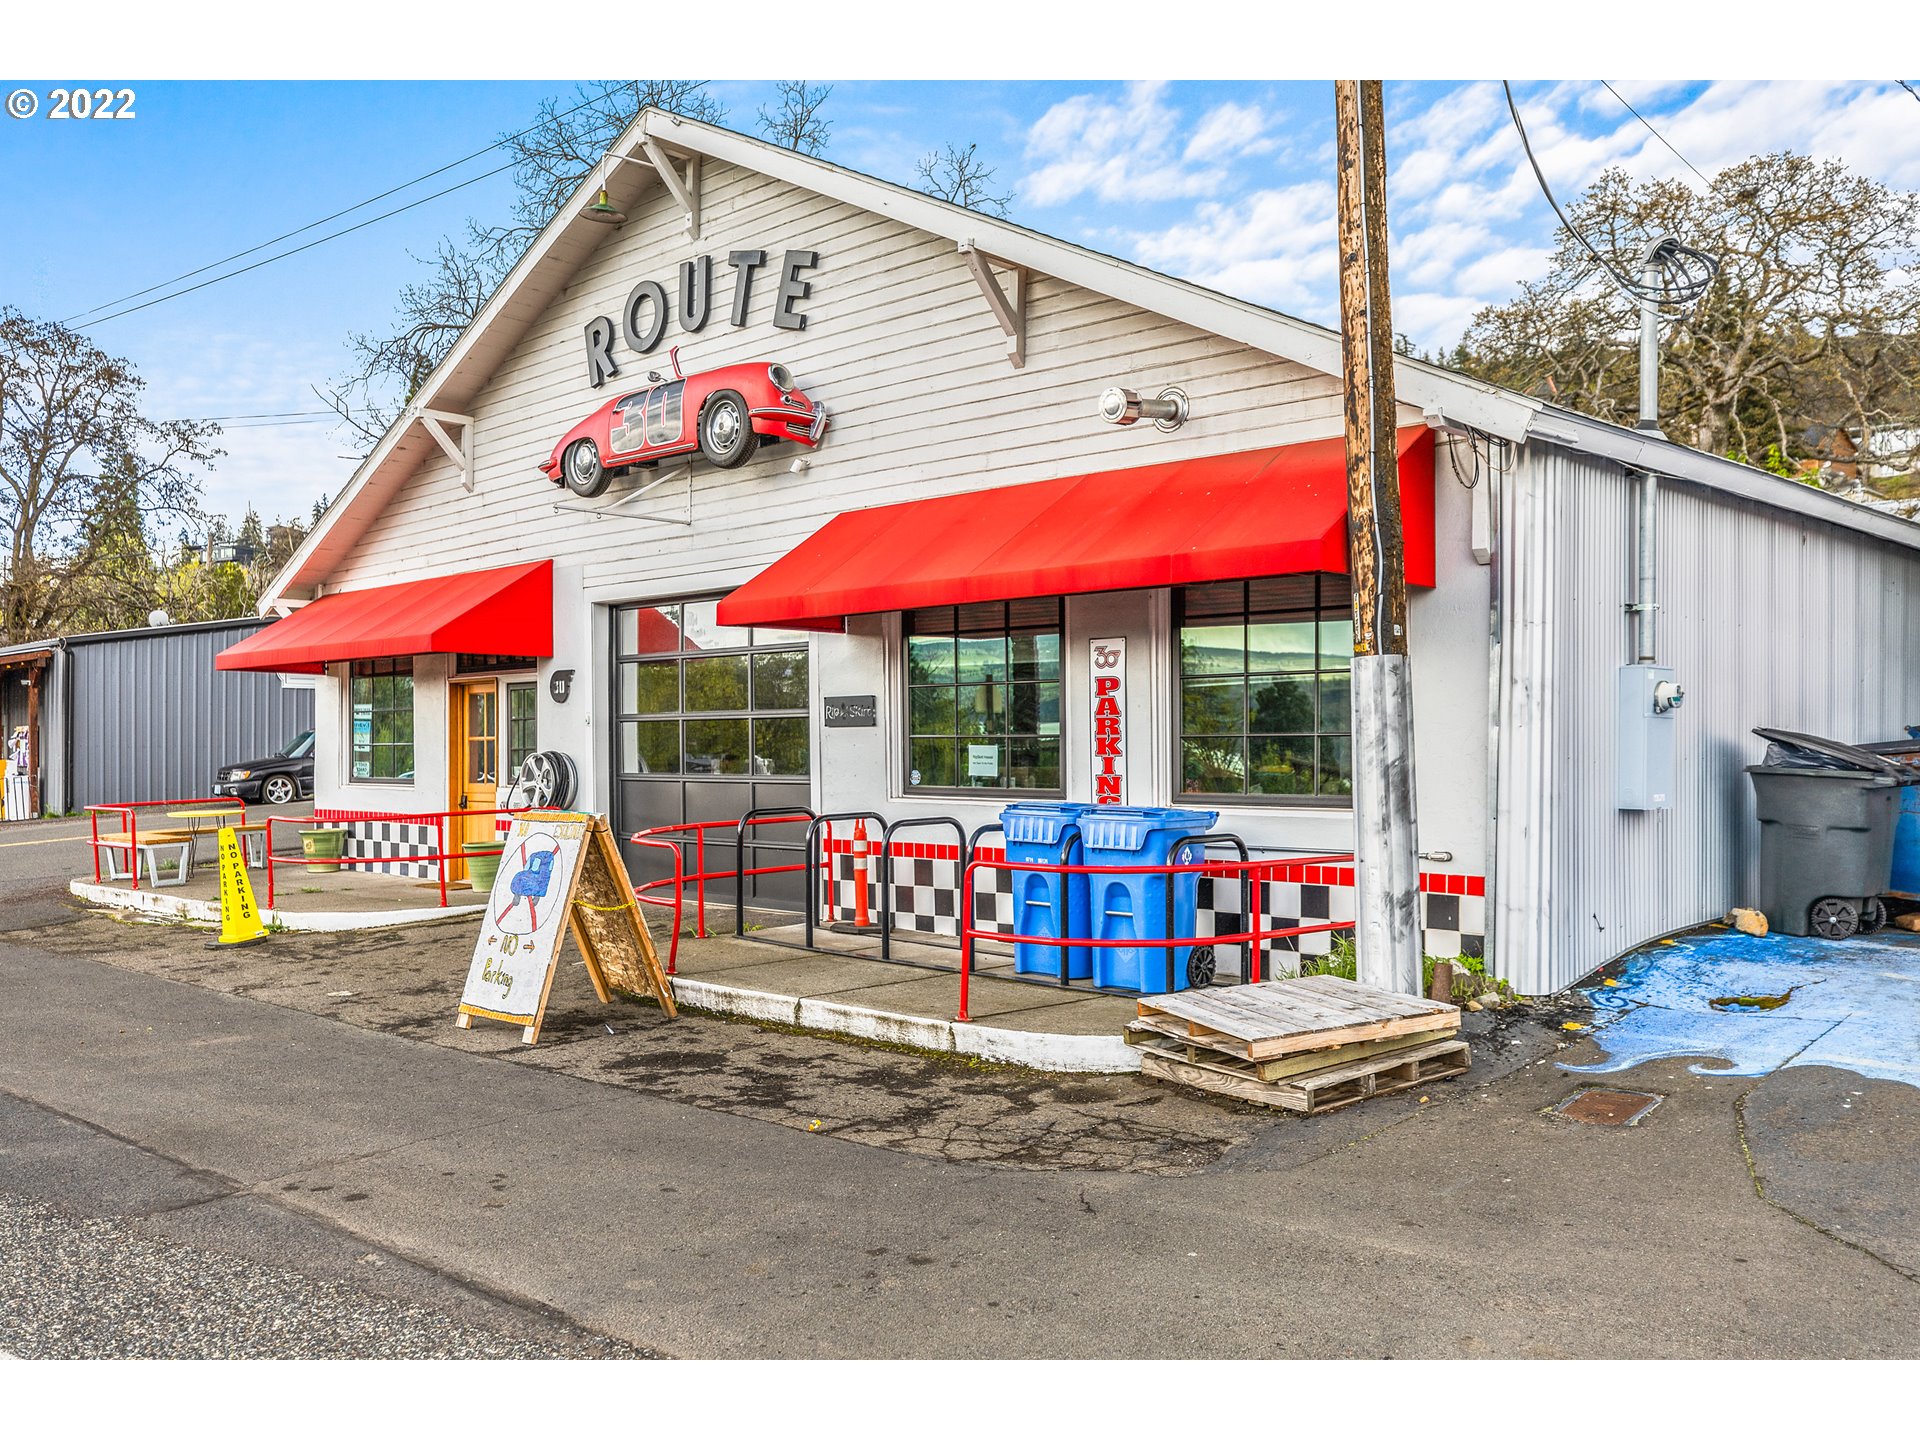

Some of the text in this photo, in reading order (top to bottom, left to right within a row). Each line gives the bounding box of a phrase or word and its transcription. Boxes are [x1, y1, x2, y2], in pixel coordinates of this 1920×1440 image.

[584, 250, 817, 389] ROUTE
[611, 379, 687, 454] 30
[1094, 645, 1121, 669] 30
[220, 845, 231, 921] NO PARKING
[228, 843, 251, 919] NO PARKING
[481, 957, 514, 1000] Parking
[499, 934, 519, 957] NO
